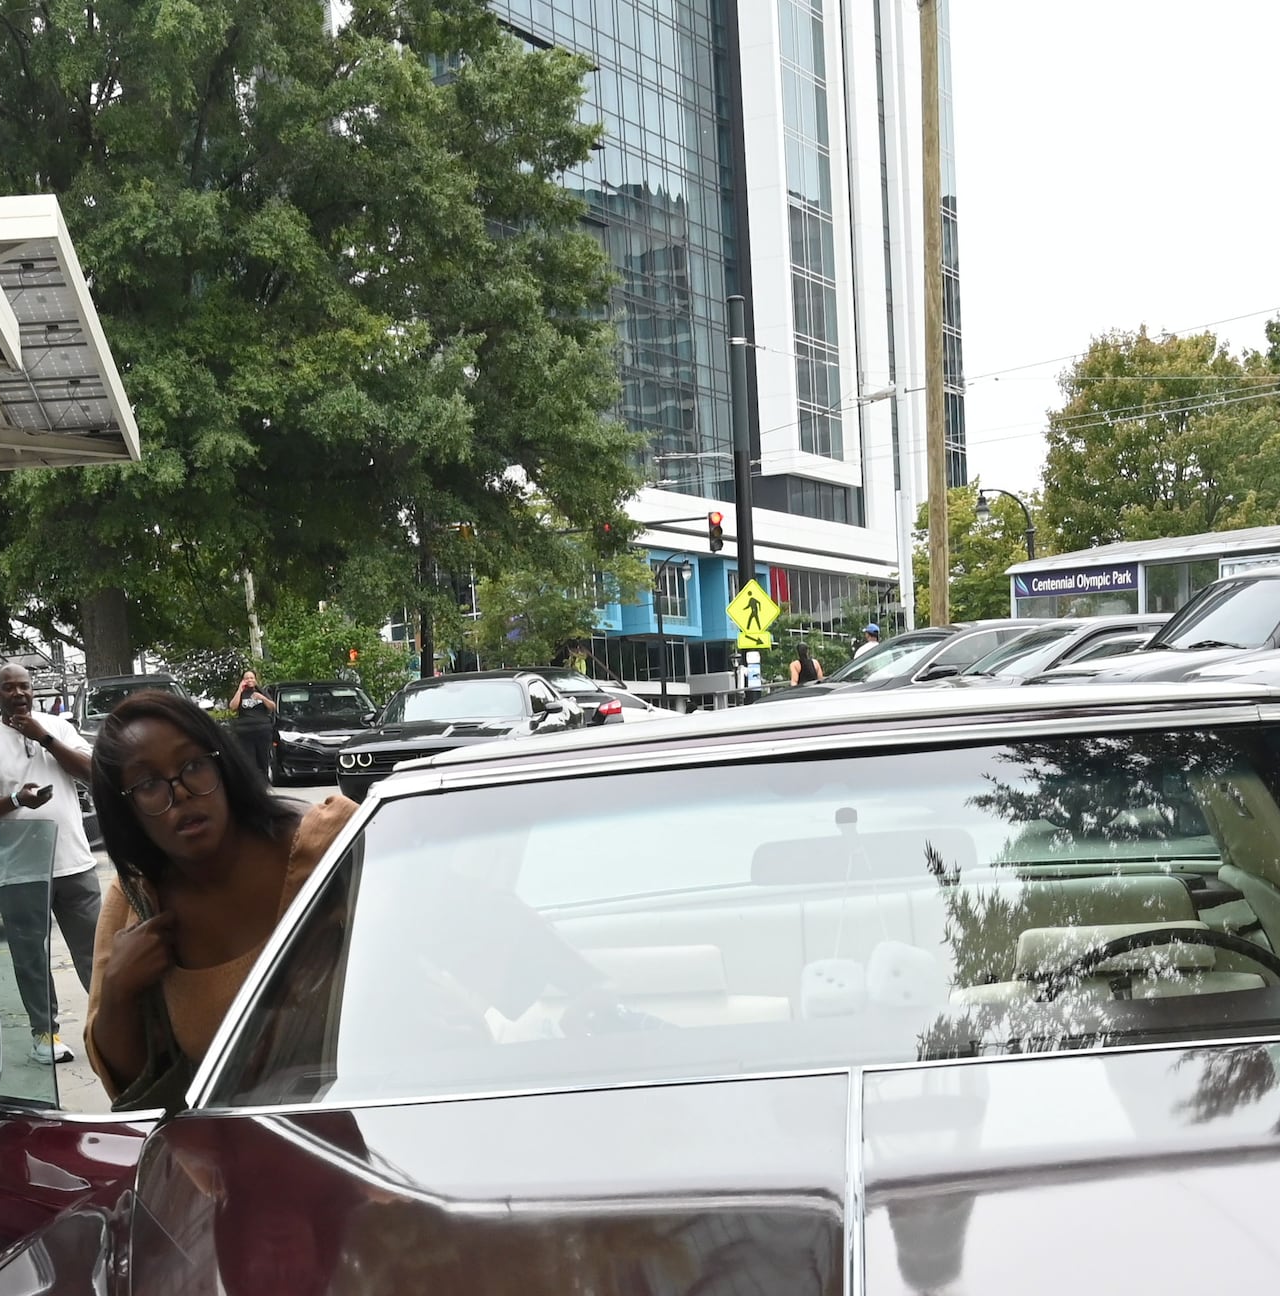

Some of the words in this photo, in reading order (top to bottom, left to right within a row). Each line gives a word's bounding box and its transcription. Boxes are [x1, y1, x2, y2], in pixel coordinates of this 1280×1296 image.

[1032, 575, 1075, 592] Centennial
[1076, 572, 1111, 591] Olympic
[1112, 569, 1132, 585] Park
